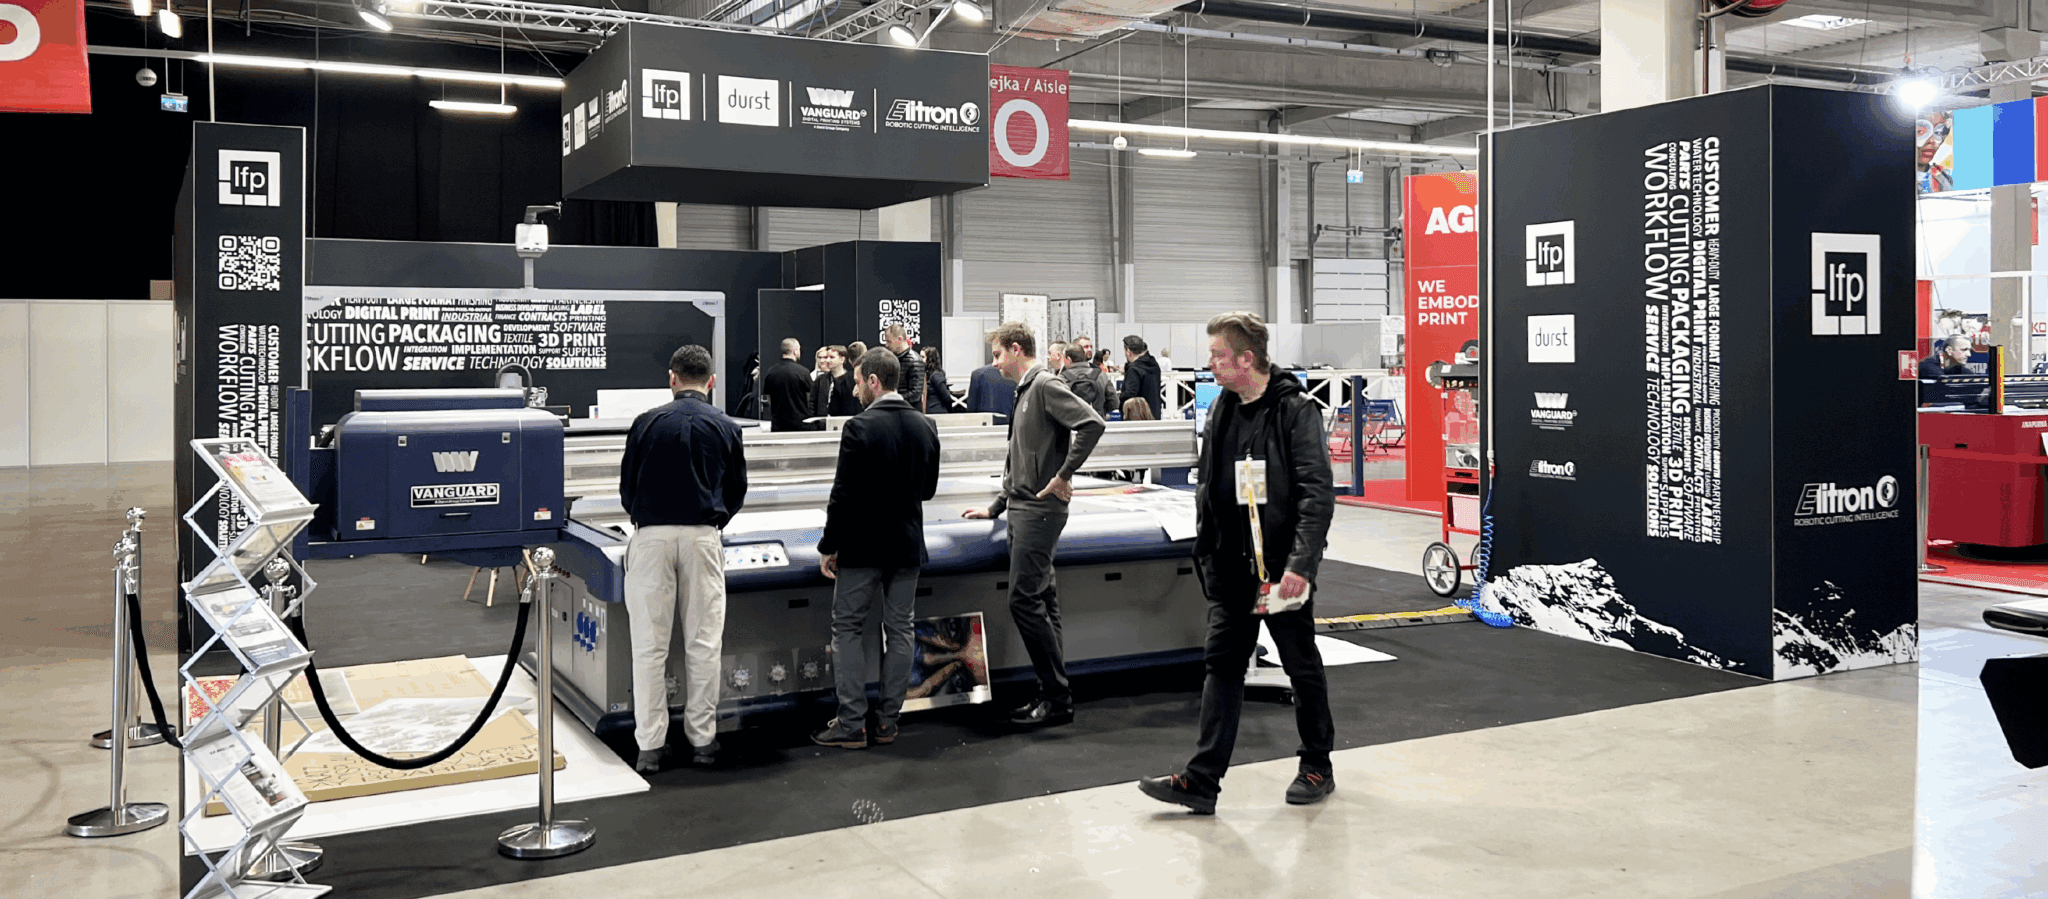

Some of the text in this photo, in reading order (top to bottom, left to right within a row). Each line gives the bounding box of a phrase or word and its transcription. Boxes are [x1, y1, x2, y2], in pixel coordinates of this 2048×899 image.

[654, 83, 679, 108] lfp
[728, 88, 771, 110] durst
[990, 76, 1067, 94] ejka / Aisle
[801, 106, 861, 120] VANGUARD
[885, 121, 980, 133] ROBOTIC CUTTING INTELLIGENCE
[886, 99, 958, 125] Elitron
[994, 99, 1049, 168] O
[234, 166, 266, 193] lfp
[1668, 142, 1677, 190] CONSULTING
[1679, 140, 1691, 190] PARTS
[1692, 137, 1703, 237] WATER TECHNOLOGY
[1704, 136, 1720, 236] CUSTOMER
[1644, 142, 1669, 300] WORKFLOW
[1538, 241, 1563, 271] lfp
[1669, 194, 1690, 284] CUTTING
[1708, 238, 1720, 280] HEAVY-DUTY
[1418, 280, 1446, 293] WE
[1693, 239, 1707, 345] DIGITAL PRINT
[1829, 263, 1864, 311] lfp
[345, 306, 440, 320] DIGITAL PRINT
[441, 312, 493, 322] INDUSTRIAL
[518, 312, 568, 321] CONTRACTS
[570, 304, 606, 315] LABEL
[1418, 311, 1468, 326] PRINT
[1708, 284, 1720, 363] LARGE FORMAT
[247, 325, 257, 355] PARTS
[307, 323, 385, 344] UTTING
[389, 324, 501, 343] PACKAGING
[503, 333, 533, 343] TEXTILE
[538, 333, 606, 347] 3D PRINT
[553, 322, 606, 332] SOFTWARE
[1535, 326, 1568, 347] durst
[1645, 304, 1660, 373] SERVICE
[1661, 304, 1669, 354] INTEGRATION
[268, 325, 280, 384] CUSTOMER
[402, 356, 465, 370] SERVICE
[404, 345, 448, 353] INTEGRATION
[452, 344, 536, 355] IMPLEMENTATION
[546, 357, 606, 369] SOLUTIONS
[561, 346, 606, 357] SUPPLIES
[1671, 287, 1692, 414] PACKAGING
[218, 324, 239, 421] WORKFLOW
[239, 356, 256, 411] CUTTING
[1692, 345, 1702, 405] INDUSTRIAL
[1708, 364, 1720, 406] FINISHING
[258, 385, 269, 419] DIGITAL
[1531, 409, 1573, 420] VANGUARD
[1660, 357, 1672, 454] IMPLEMENTATION
[1646, 378, 1660, 465] TECHNOLOGY
[1672, 416, 1683, 452] TEXTILE
[1713, 408, 1721, 450] PRODUCTIVITY
[1683, 416, 1691, 472] DEVELOPMENT
[1693, 435, 1704, 494] CONTRACTS
[413, 485, 497, 499] VANGUARD
[1647, 463, 1660, 537] SOLUTIONS
[1668, 456, 1684, 541] 3D PRINT
[1683, 475, 1694, 541] SOFTWARE
[1794, 482, 1874, 516] Elitron
[236, 514, 248, 529] 3D
[1659, 483, 1669, 538] SUPPLIES
[1701, 497, 1713, 543] LABEL
[1712, 479, 1721, 545] PARTNERSHIP
[1793, 510, 1899, 527] ROBOTIC CUTTING INTELLIGENCE
